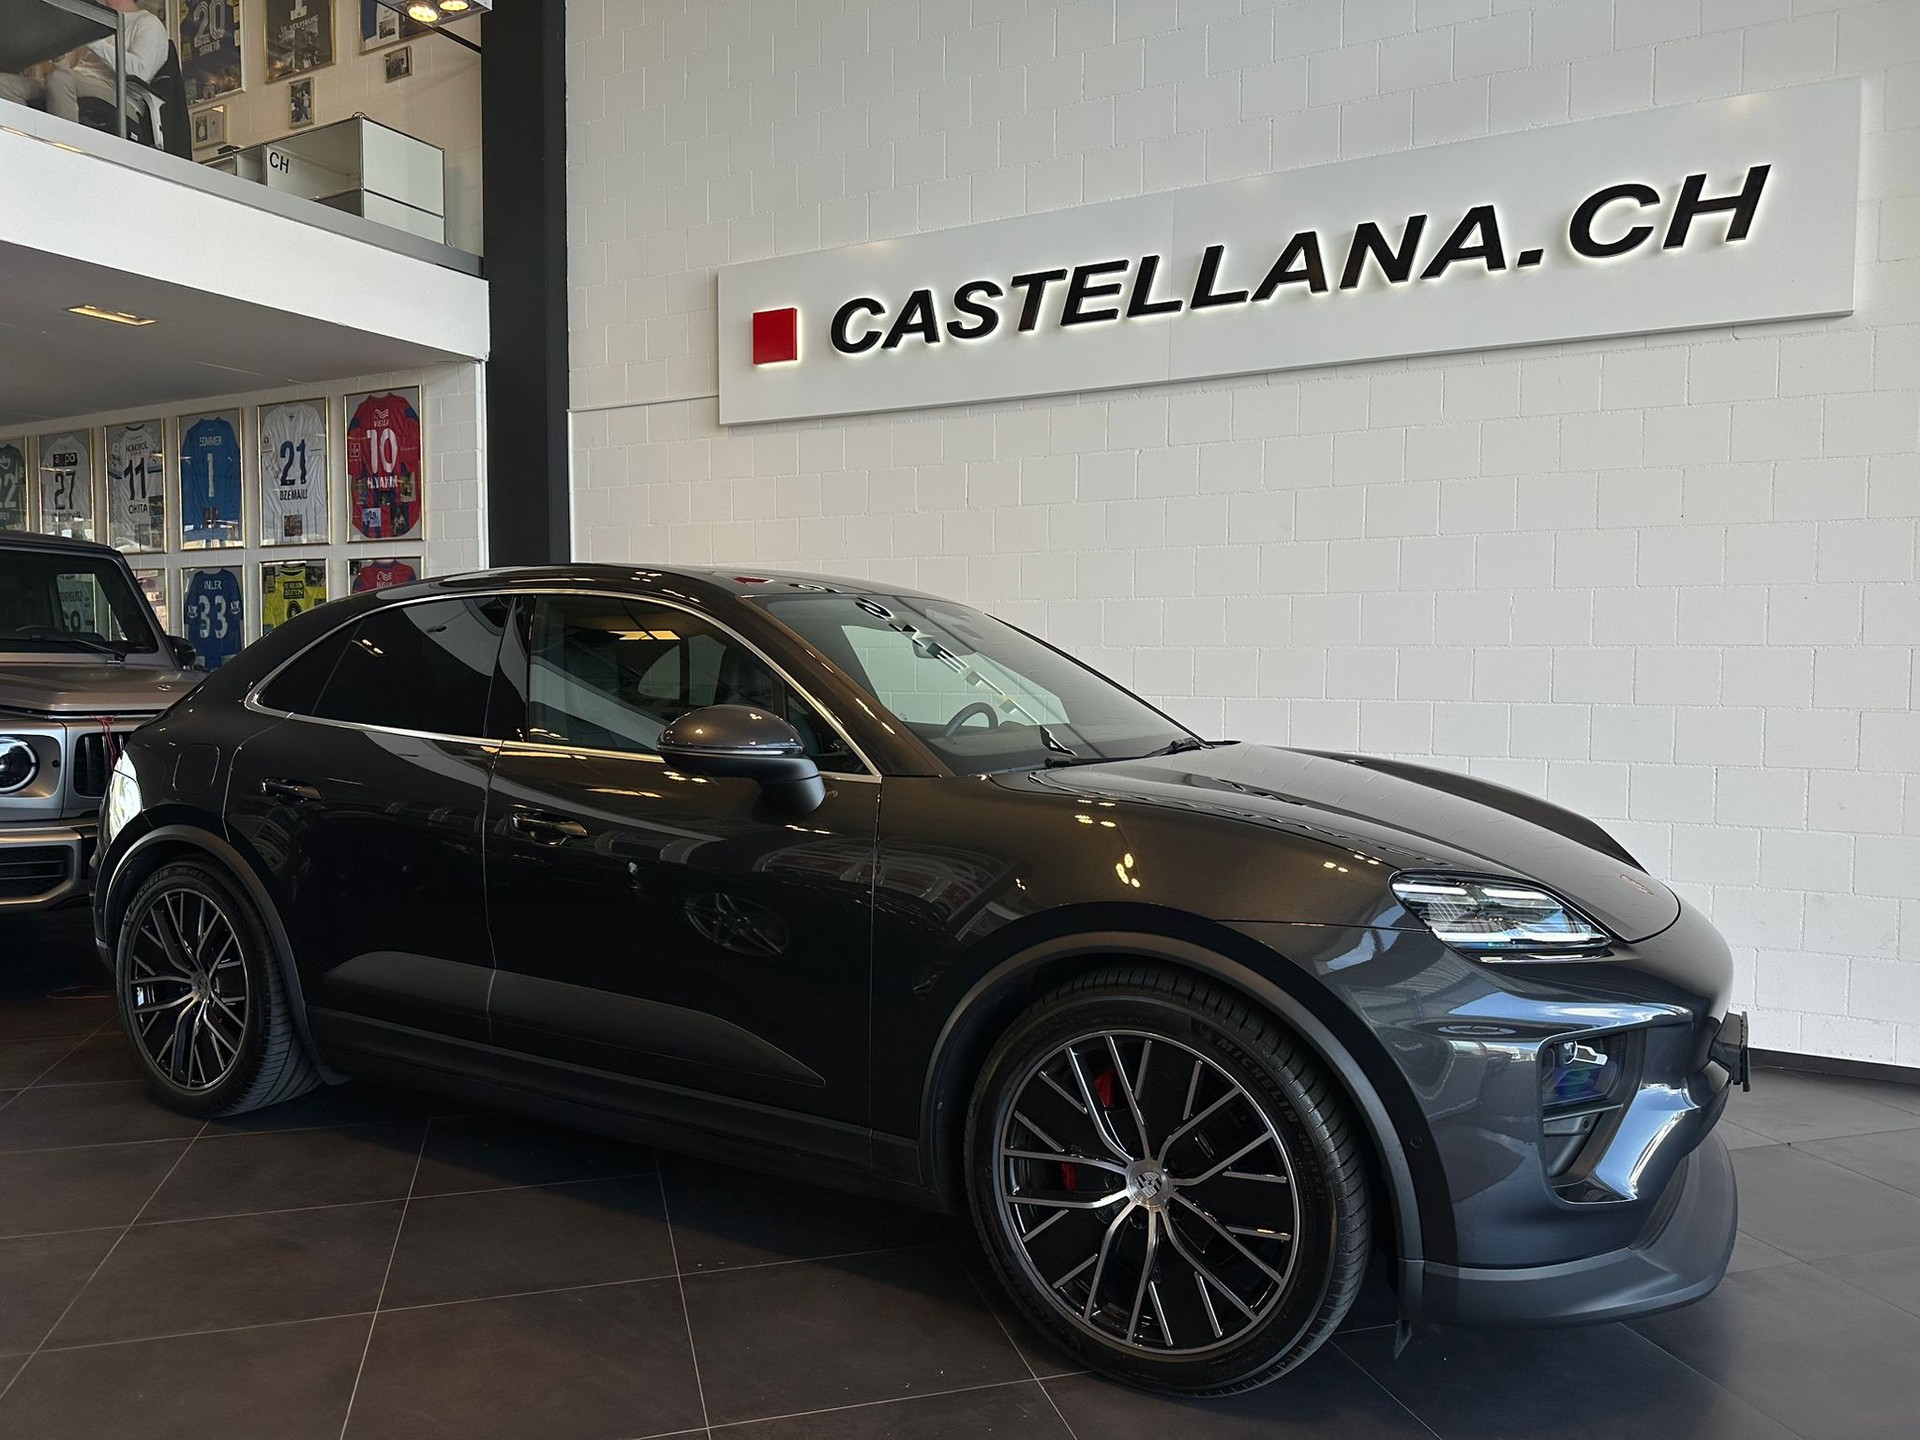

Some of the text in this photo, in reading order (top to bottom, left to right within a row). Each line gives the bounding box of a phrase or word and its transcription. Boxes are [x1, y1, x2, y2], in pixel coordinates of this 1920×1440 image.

[194, 0, 226, 47] 20
[269, 151, 290, 174] CH
[830, 164, 1771, 353] CASTELLANA.CH
[199, 435, 223, 447] SOMMER
[280, 439, 307, 486] 21
[366, 428, 398, 474] 10
[55, 470, 76, 509] 27
[124, 457, 147, 500] 11
[207, 452, 215, 498] 1
[128, 503, 148, 515] OKITA
[203, 580, 222, 591] INLER
[199, 595, 228, 639] 33
[1217, 1036, 1299, 1123] MICHELIN
